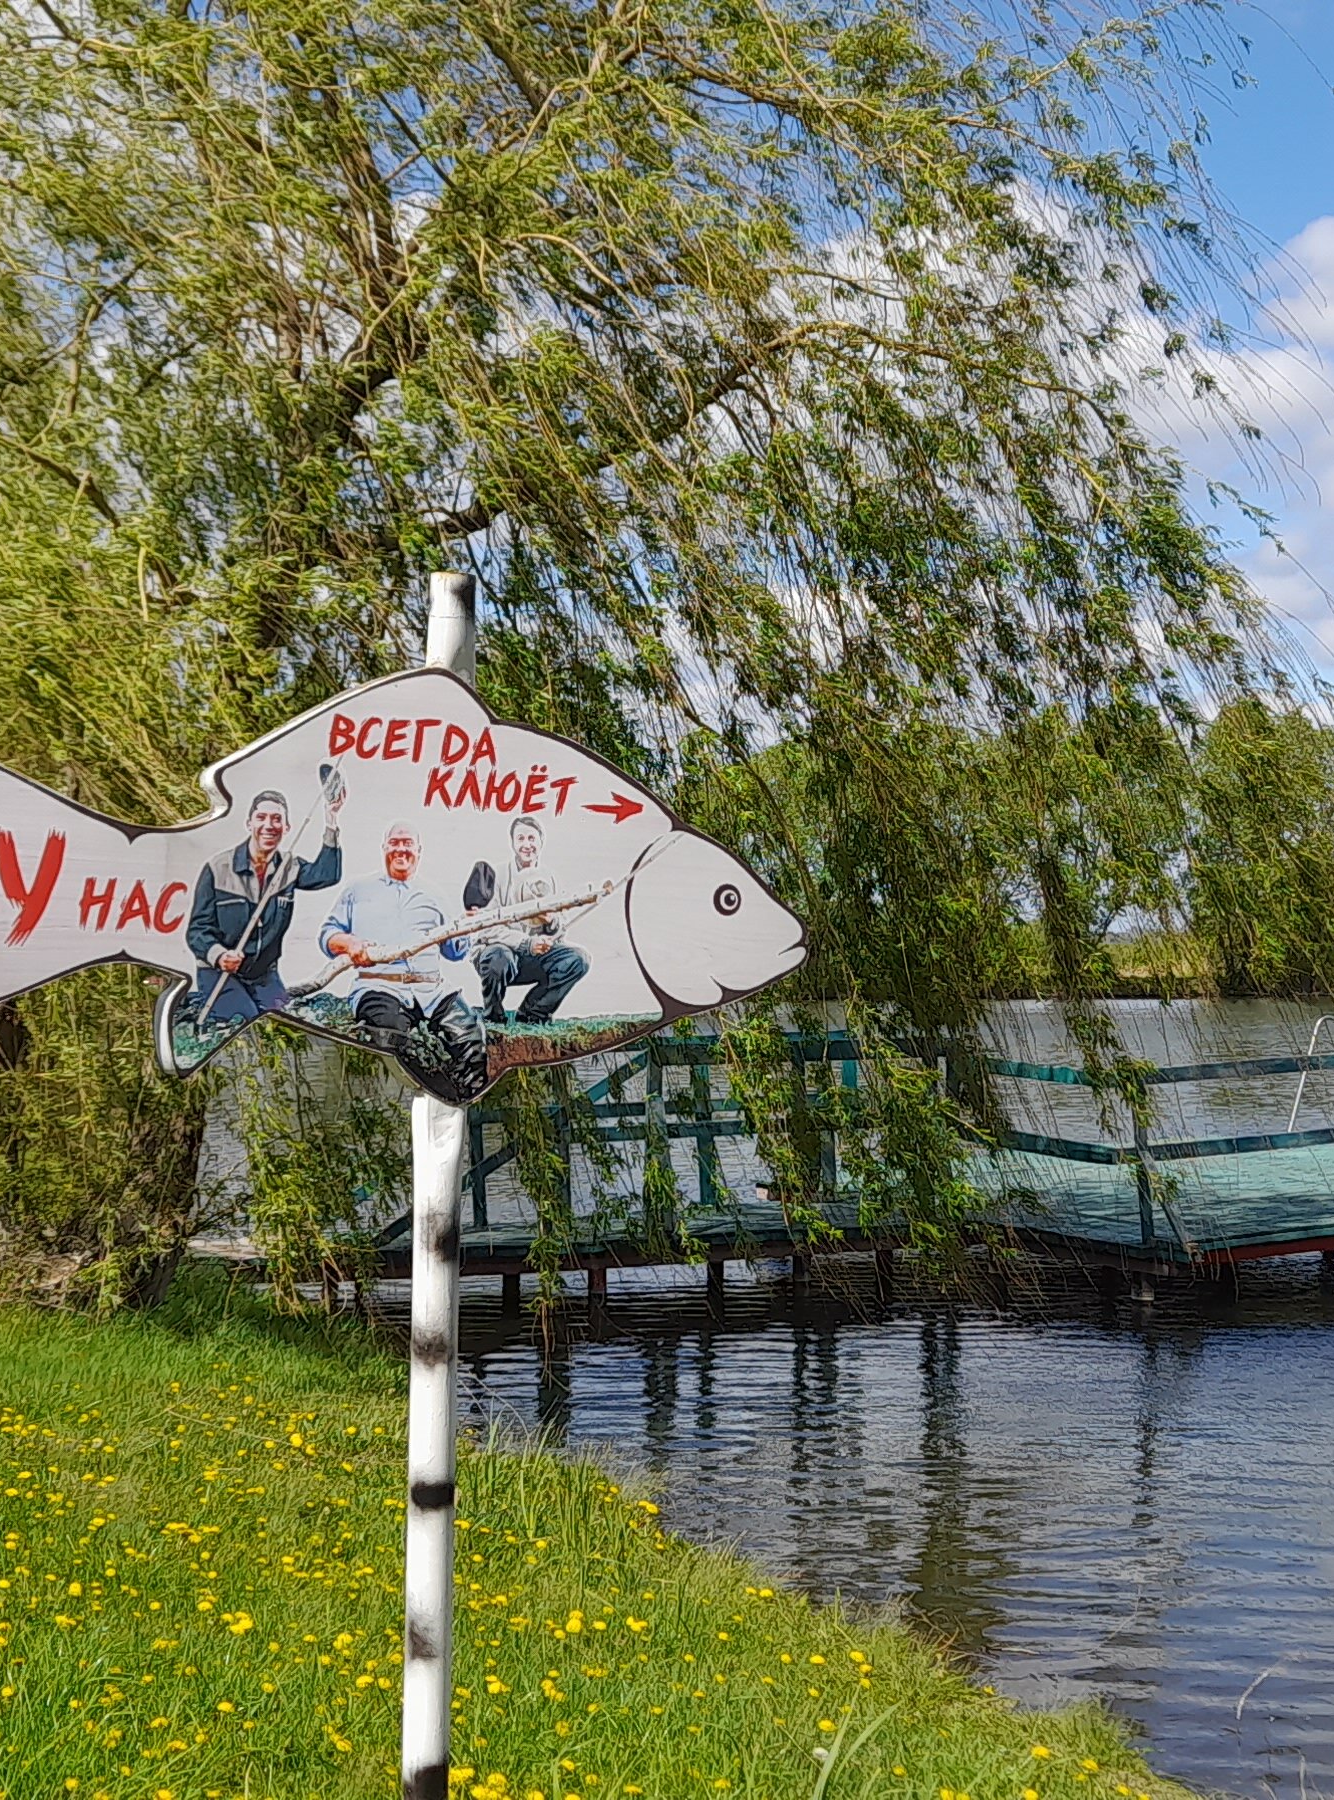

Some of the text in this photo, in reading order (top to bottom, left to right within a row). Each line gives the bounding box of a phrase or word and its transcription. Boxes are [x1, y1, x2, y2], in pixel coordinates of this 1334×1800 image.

[329, 714, 498, 766] ВСЕГДА
[424, 765, 578, 816] КЛЮЁТ
[79, 877, 188, 934] НАС
